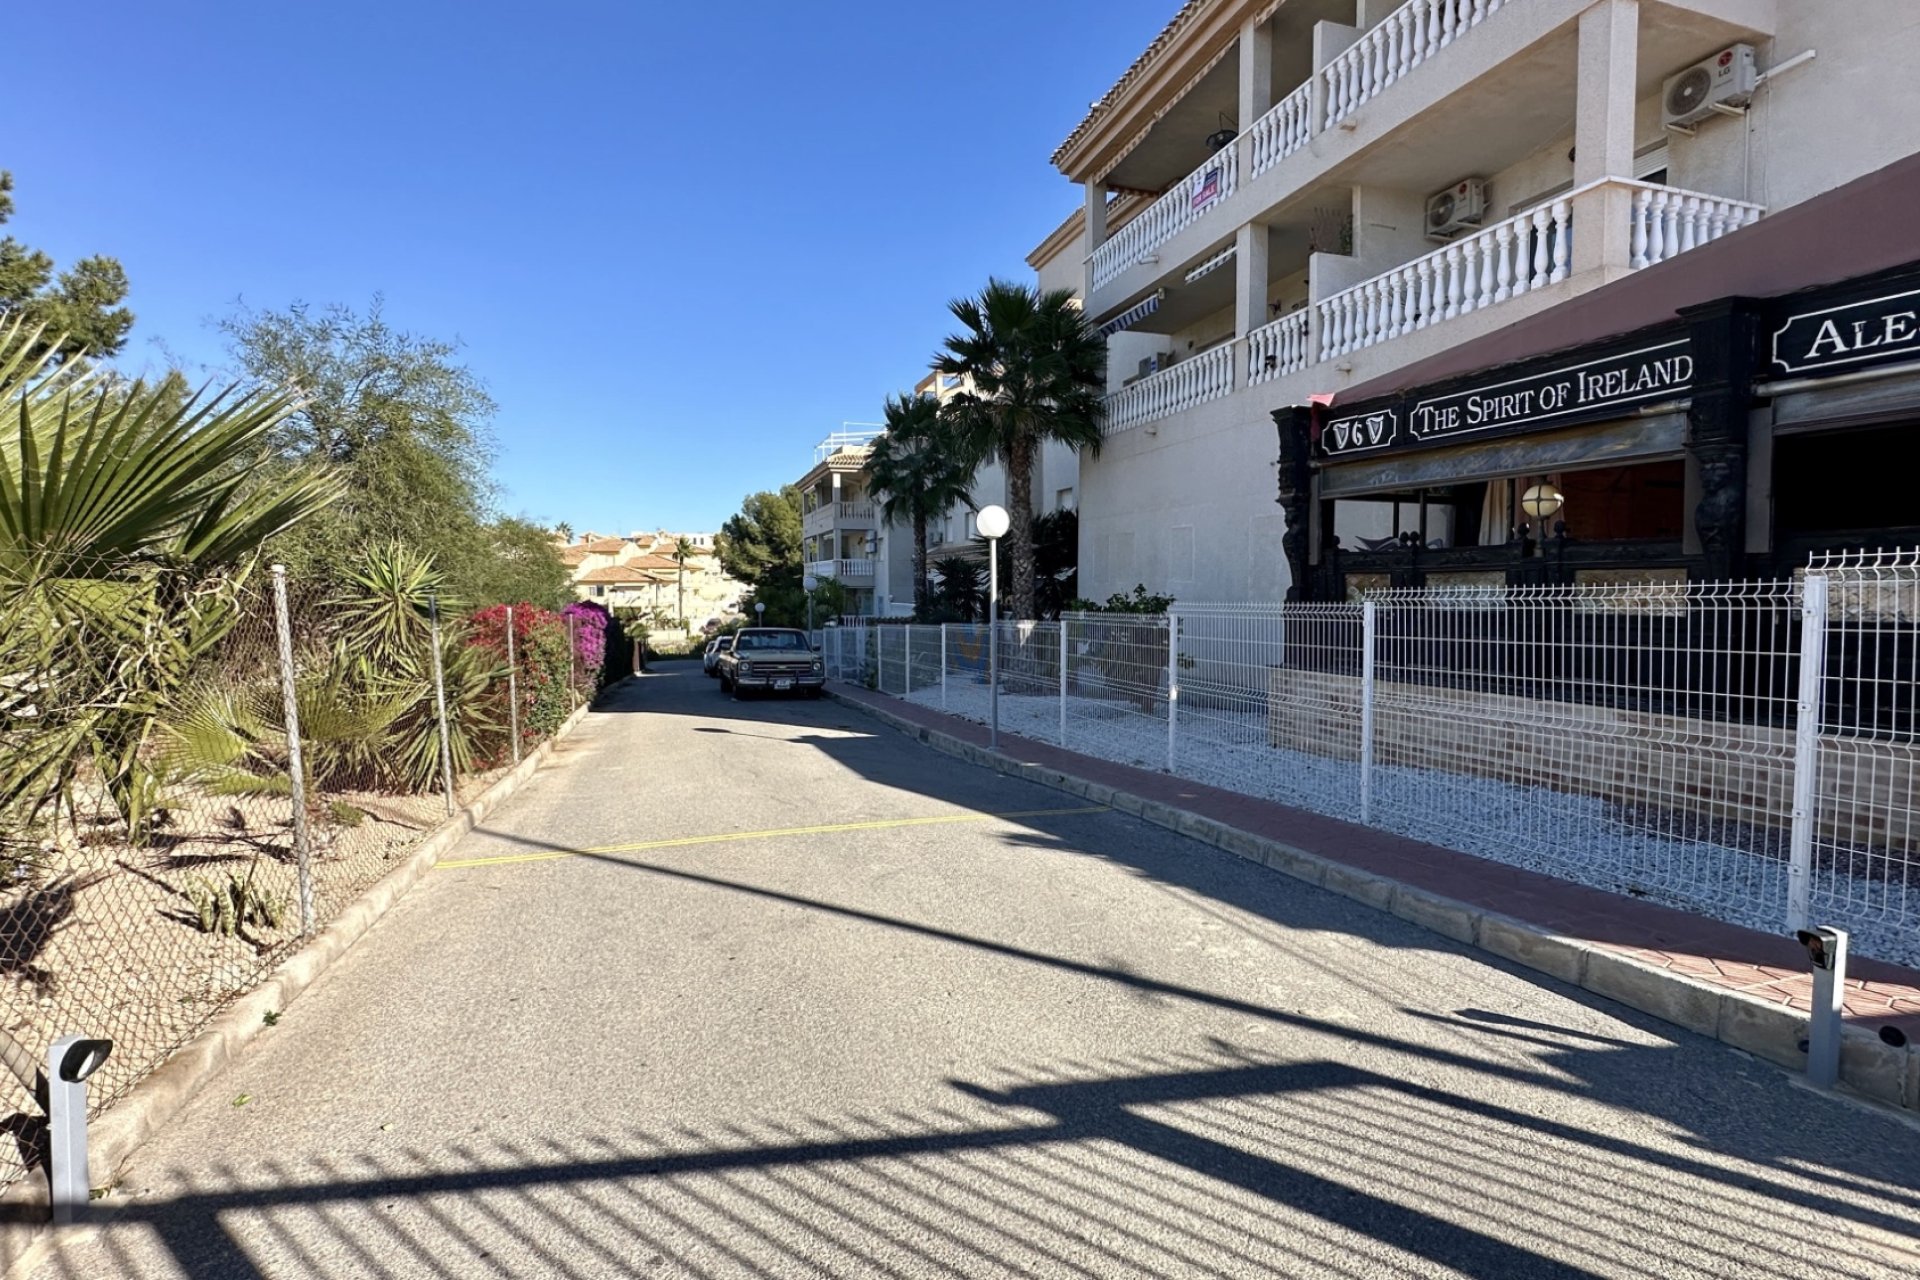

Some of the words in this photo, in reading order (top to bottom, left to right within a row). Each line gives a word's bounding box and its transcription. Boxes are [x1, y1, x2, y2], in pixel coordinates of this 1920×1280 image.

[1803, 311, 1920, 359] ALE
[1418, 405, 1460, 433] THE
[1466, 390, 1535, 424] SPIRIT
[1539, 382, 1571, 410] OF
[1577, 355, 1694, 403] IRELAND
